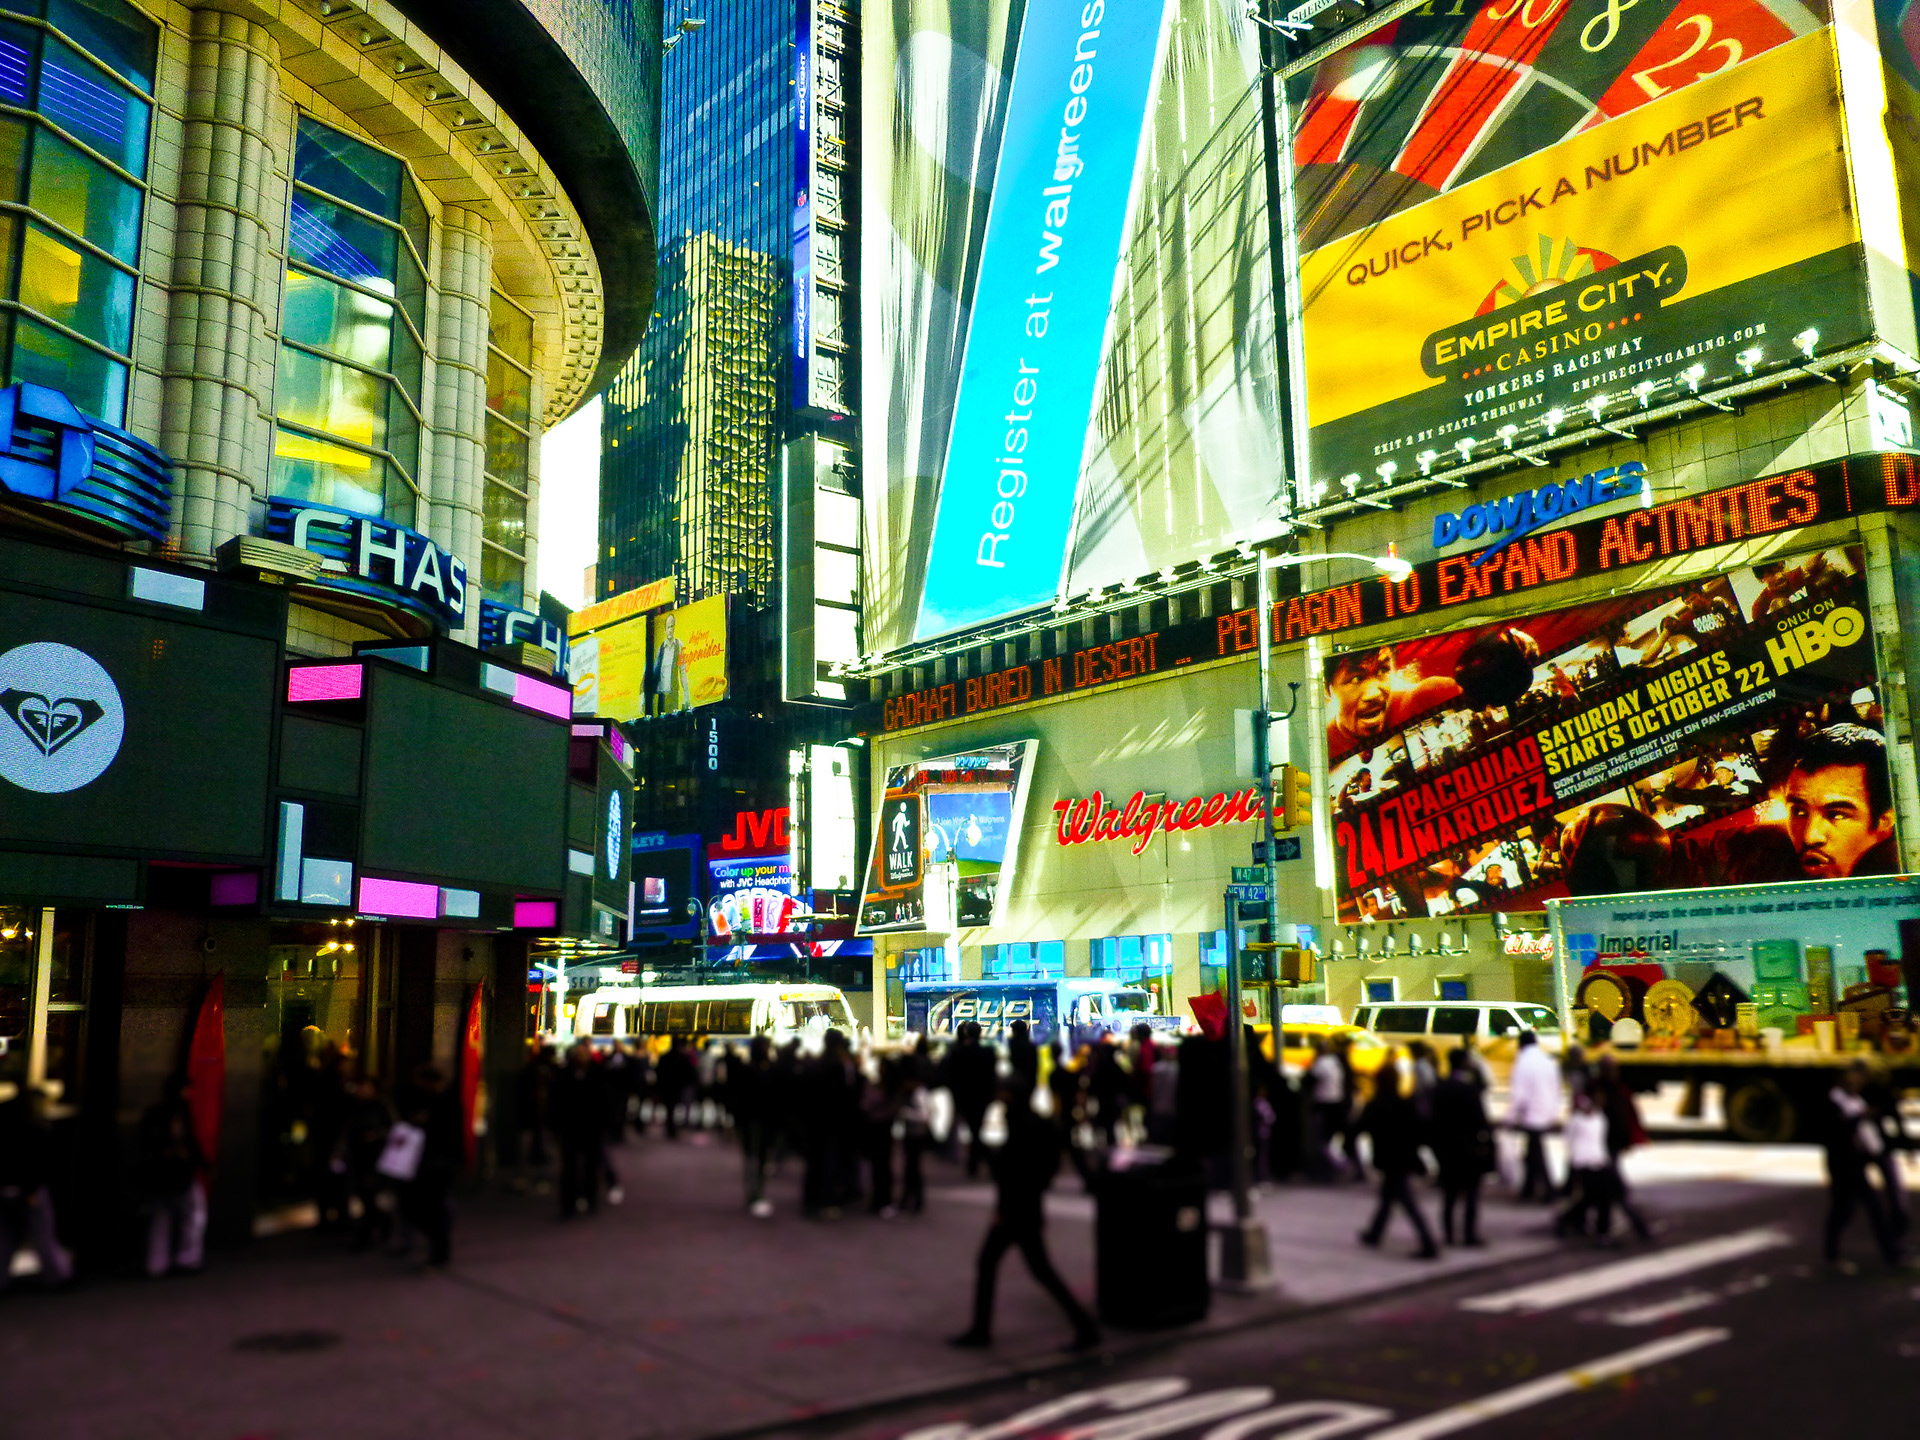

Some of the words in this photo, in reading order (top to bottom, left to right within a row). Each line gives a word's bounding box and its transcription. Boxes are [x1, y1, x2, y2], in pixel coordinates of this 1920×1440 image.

[1035, 0, 1105, 275] walgreens
[1346, 229, 1453, 287] QUICK,
[1461, 186, 1546, 243] PICK
[1550, 177, 1577, 206] A
[1584, 96, 1767, 190] NUMBER
[1025, 292, 1053, 338] at
[1435, 300, 1568, 366] EMPIRE
[1496, 322, 1603, 372] CASINO
[1373, 438, 1402, 456] EXIT
[1406, 435, 1414, 446] 2
[1417, 428, 1433, 442] NY
[1438, 415, 1477, 436] STATE
[1482, 393, 1544, 422] THRUWAY
[1572, 322, 1768, 393] EMPIRECITYGAMING.COM
[1464, 369, 1546, 407] YONKERS
[1553, 336, 1643, 378] RACEWAY
[976, 358, 1040, 568] Register
[292, 508, 467, 615] CHAS
[883, 683, 956, 732] GADHAFI
[966, 665, 1032, 713] BURIED
[1043, 658, 1063, 695] IN
[1075, 632, 1160, 688] DESERT
[1378, 568, 1422, 618] TO
[1436, 530, 1578, 606] EXPAND
[1881, 452, 1920, 507] D
[505, 611, 569, 677] CH
[1765, 606, 1865, 677] HBO
[1777, 608, 1812, 632] ONLY
[1813, 598, 1835, 615] ON
[1537, 689, 1641, 752] SATURDAY
[1646, 650, 1731, 704] NIGHTS
[1544, 725, 1625, 776] STARTS
[1628, 677, 1732, 740] OCTOBER
[1734, 660, 1770, 694] 22
[708, 718, 719, 772] 1500
[1552, 772, 1582, 790] DON'T
[1583, 762, 1608, 780] MISS
[1609, 752, 1629, 769] THE
[1629, 740, 1658, 761] FIGHT
[1659, 728, 1684, 746] LIVE
[1684, 722, 1700, 735] ON
[1700, 688, 1777, 728] PAY-PER-VIEW
[1608, 747, 1664, 780] NOVEMBER
[1402, 735, 1543, 824] PACQUIAO
[722, 806, 791, 850] JVC
[1412, 772, 1554, 858] MARQUEZ
[714, 866, 739, 878] Color
[740, 867, 754, 878] up
[755, 865, 777, 877] your
[720, 879, 735, 889] with
[736, 877, 753, 888] JVC
[754, 875, 793, 887] Headphon
[889, 851, 913, 871] WALK
[1235, 868, 1243, 881] W
[1242, 868, 1252, 881] 47
[1248, 887, 1259, 900] 42
[1600, 929, 1679, 956] Imperial
[954, 998, 1033, 1018] BUD
